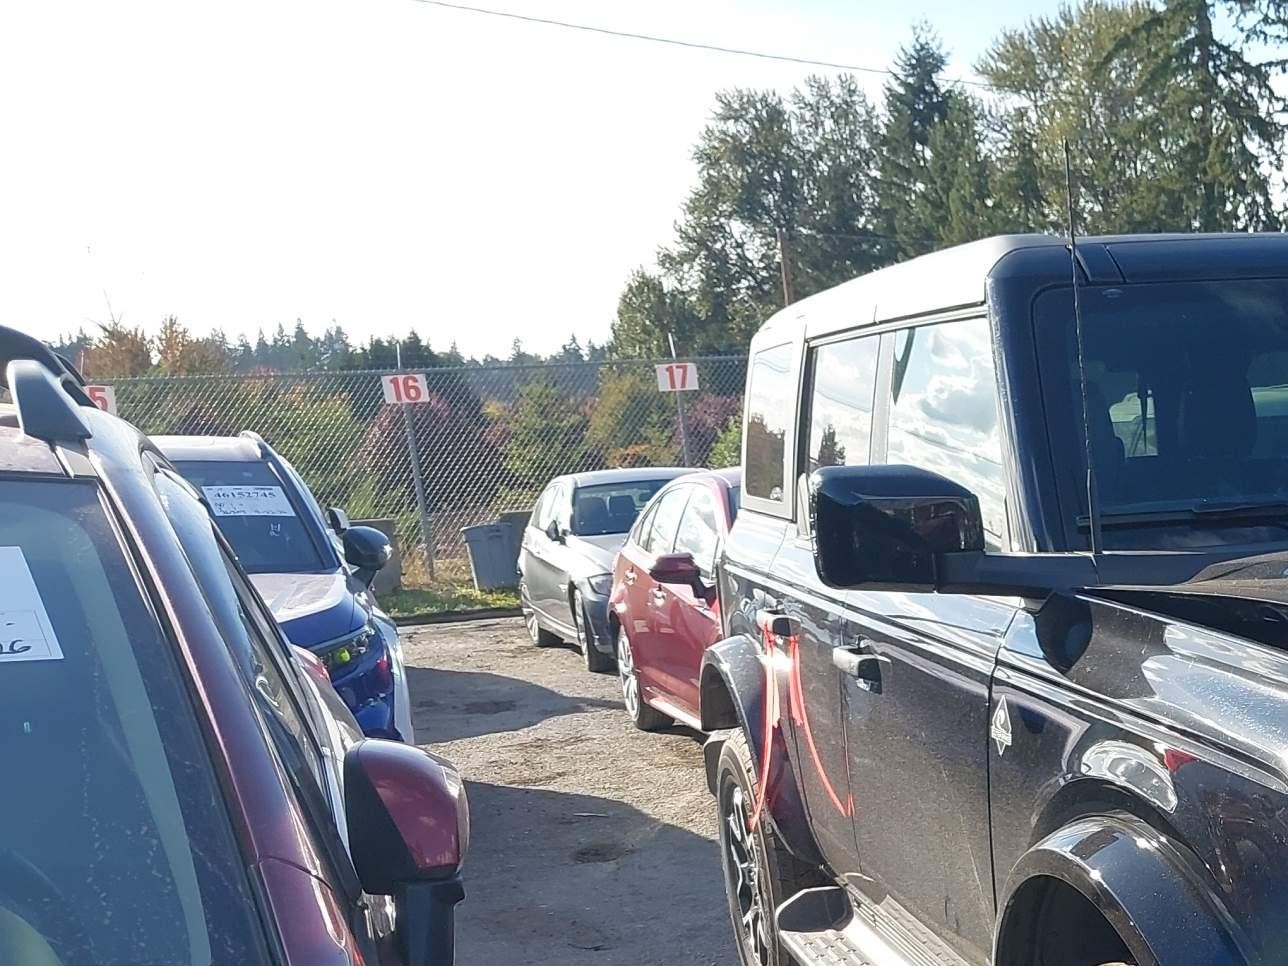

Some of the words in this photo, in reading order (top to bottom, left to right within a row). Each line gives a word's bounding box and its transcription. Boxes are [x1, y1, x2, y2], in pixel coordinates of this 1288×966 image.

[390, 375, 422, 401] 16
[666, 365, 688, 390] 17
[88, 387, 108, 411] 5
